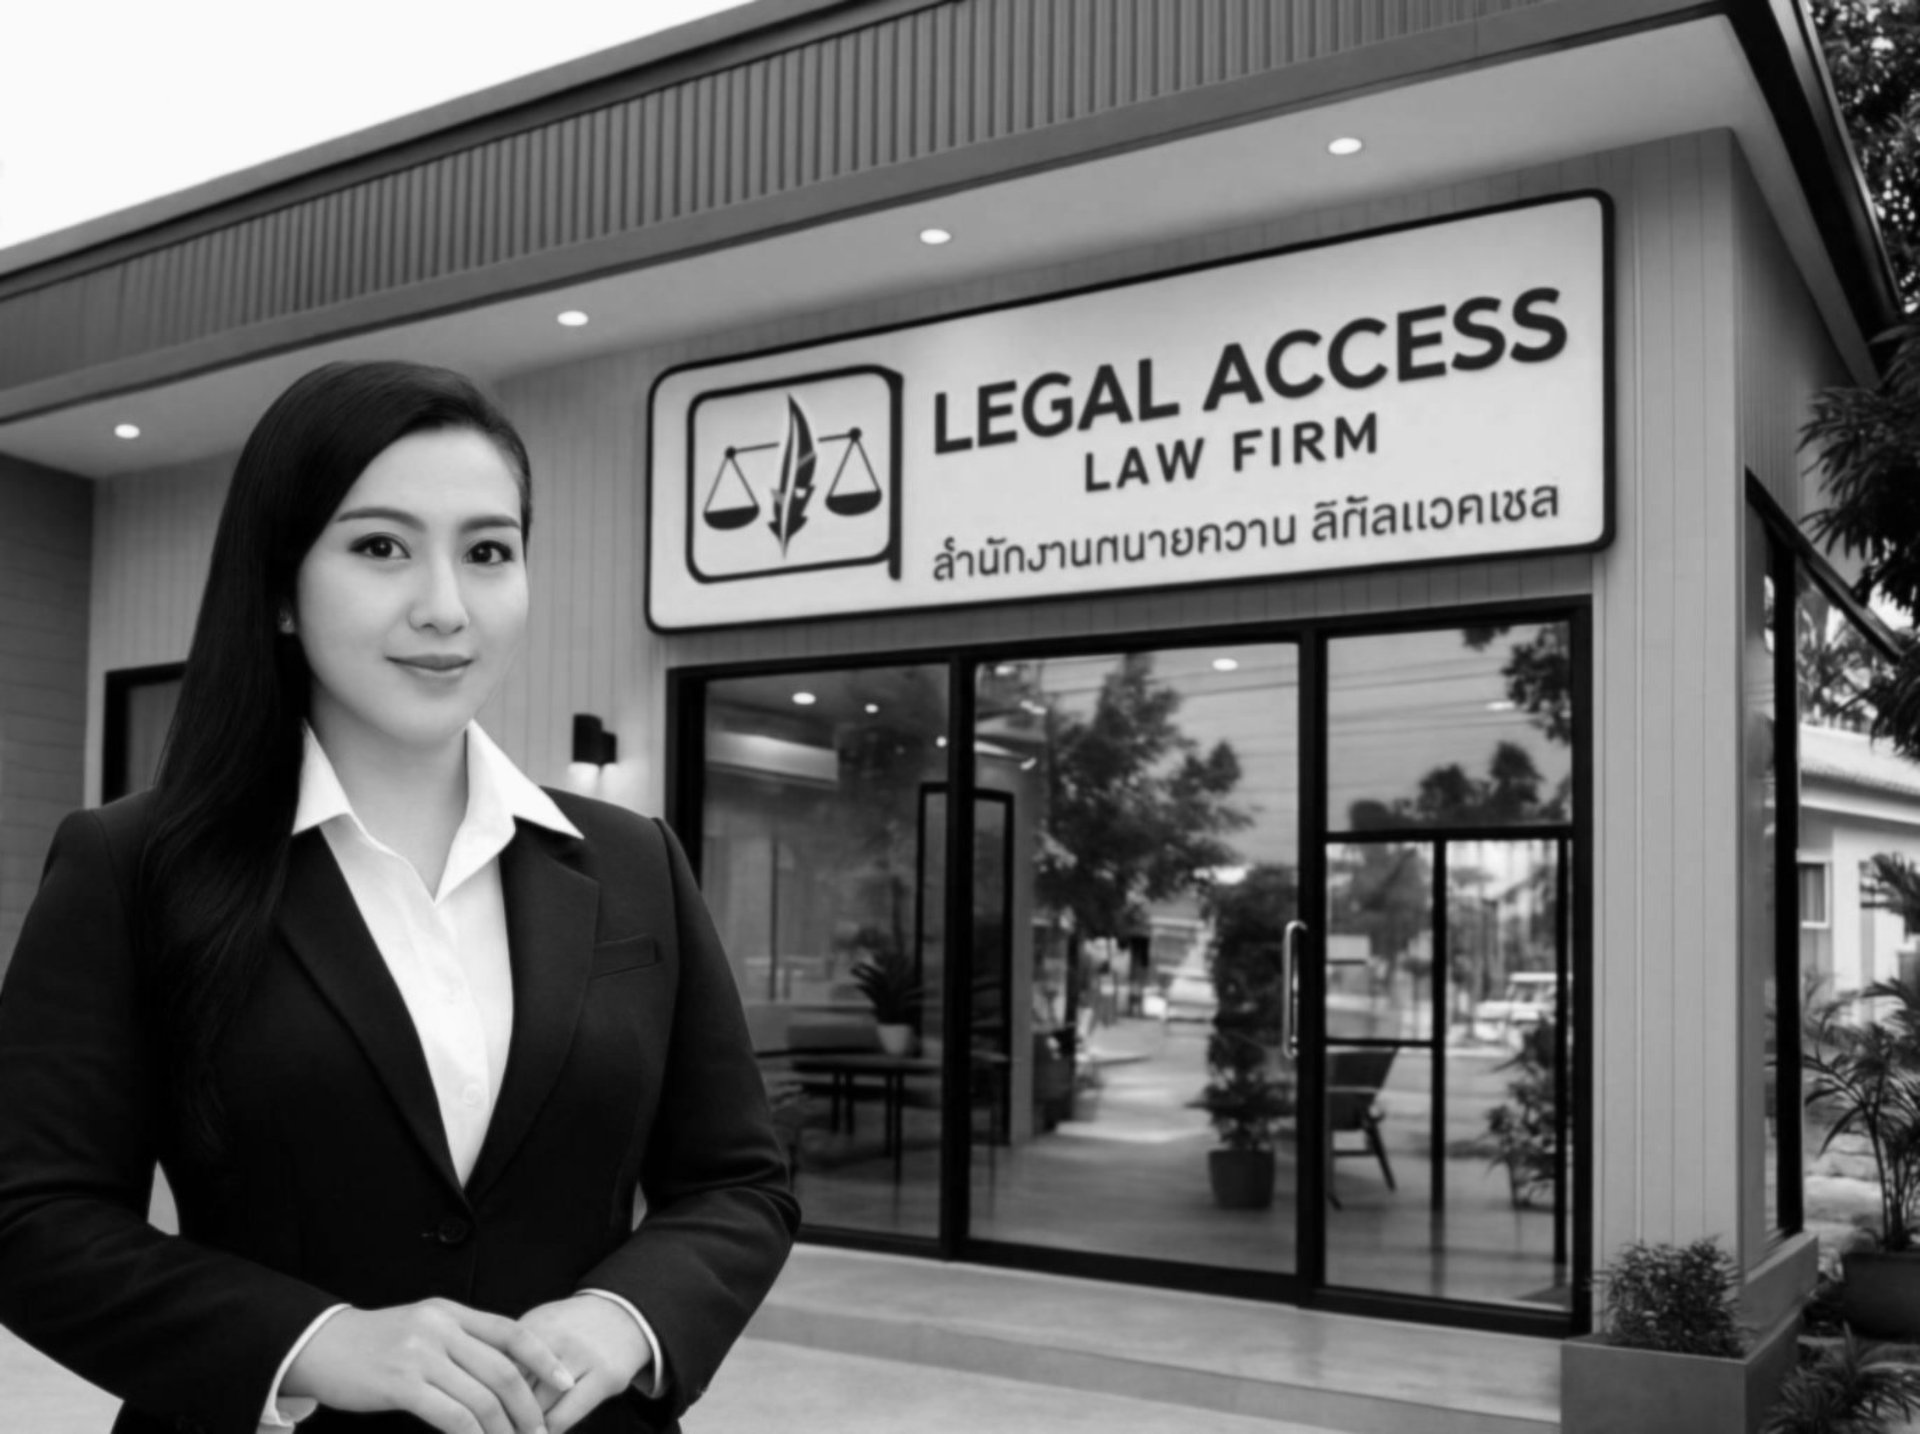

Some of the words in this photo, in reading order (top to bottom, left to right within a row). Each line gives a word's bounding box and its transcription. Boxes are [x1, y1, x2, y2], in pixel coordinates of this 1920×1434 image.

[934, 357, 1181, 456] LEGAL
[1202, 286, 1568, 412] ACCESS
[1085, 437, 1205, 493] LAW
[1233, 412, 1378, 473] FIRM
